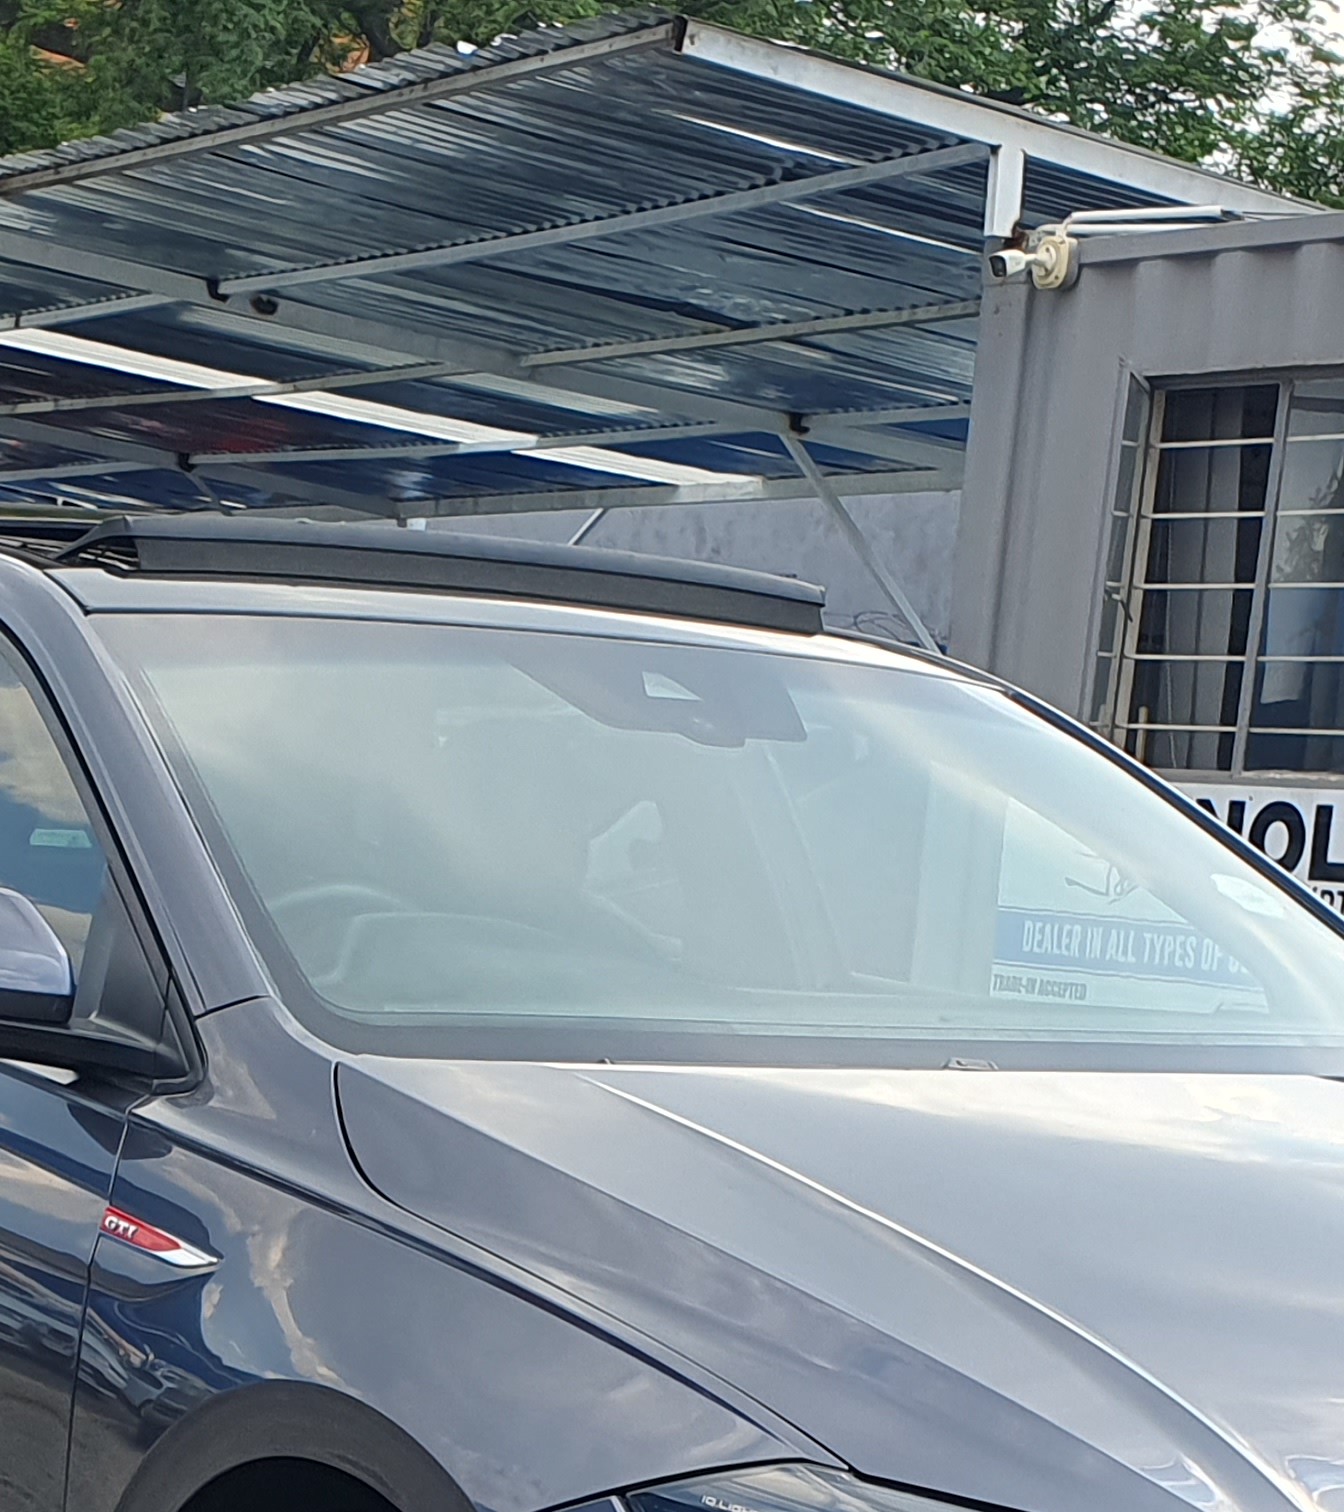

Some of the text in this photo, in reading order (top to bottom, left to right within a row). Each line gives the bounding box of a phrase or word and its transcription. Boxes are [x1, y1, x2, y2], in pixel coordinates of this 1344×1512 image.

[1022, 920, 1080, 959] DEALER
[1085, 925, 1103, 959] IN
[1106, 928, 1136, 964] ALL
[1143, 932, 1196, 970] TYPES
[1037, 978, 1088, 1000] ACCEPTED
[104, 1215, 138, 1240] GTI
